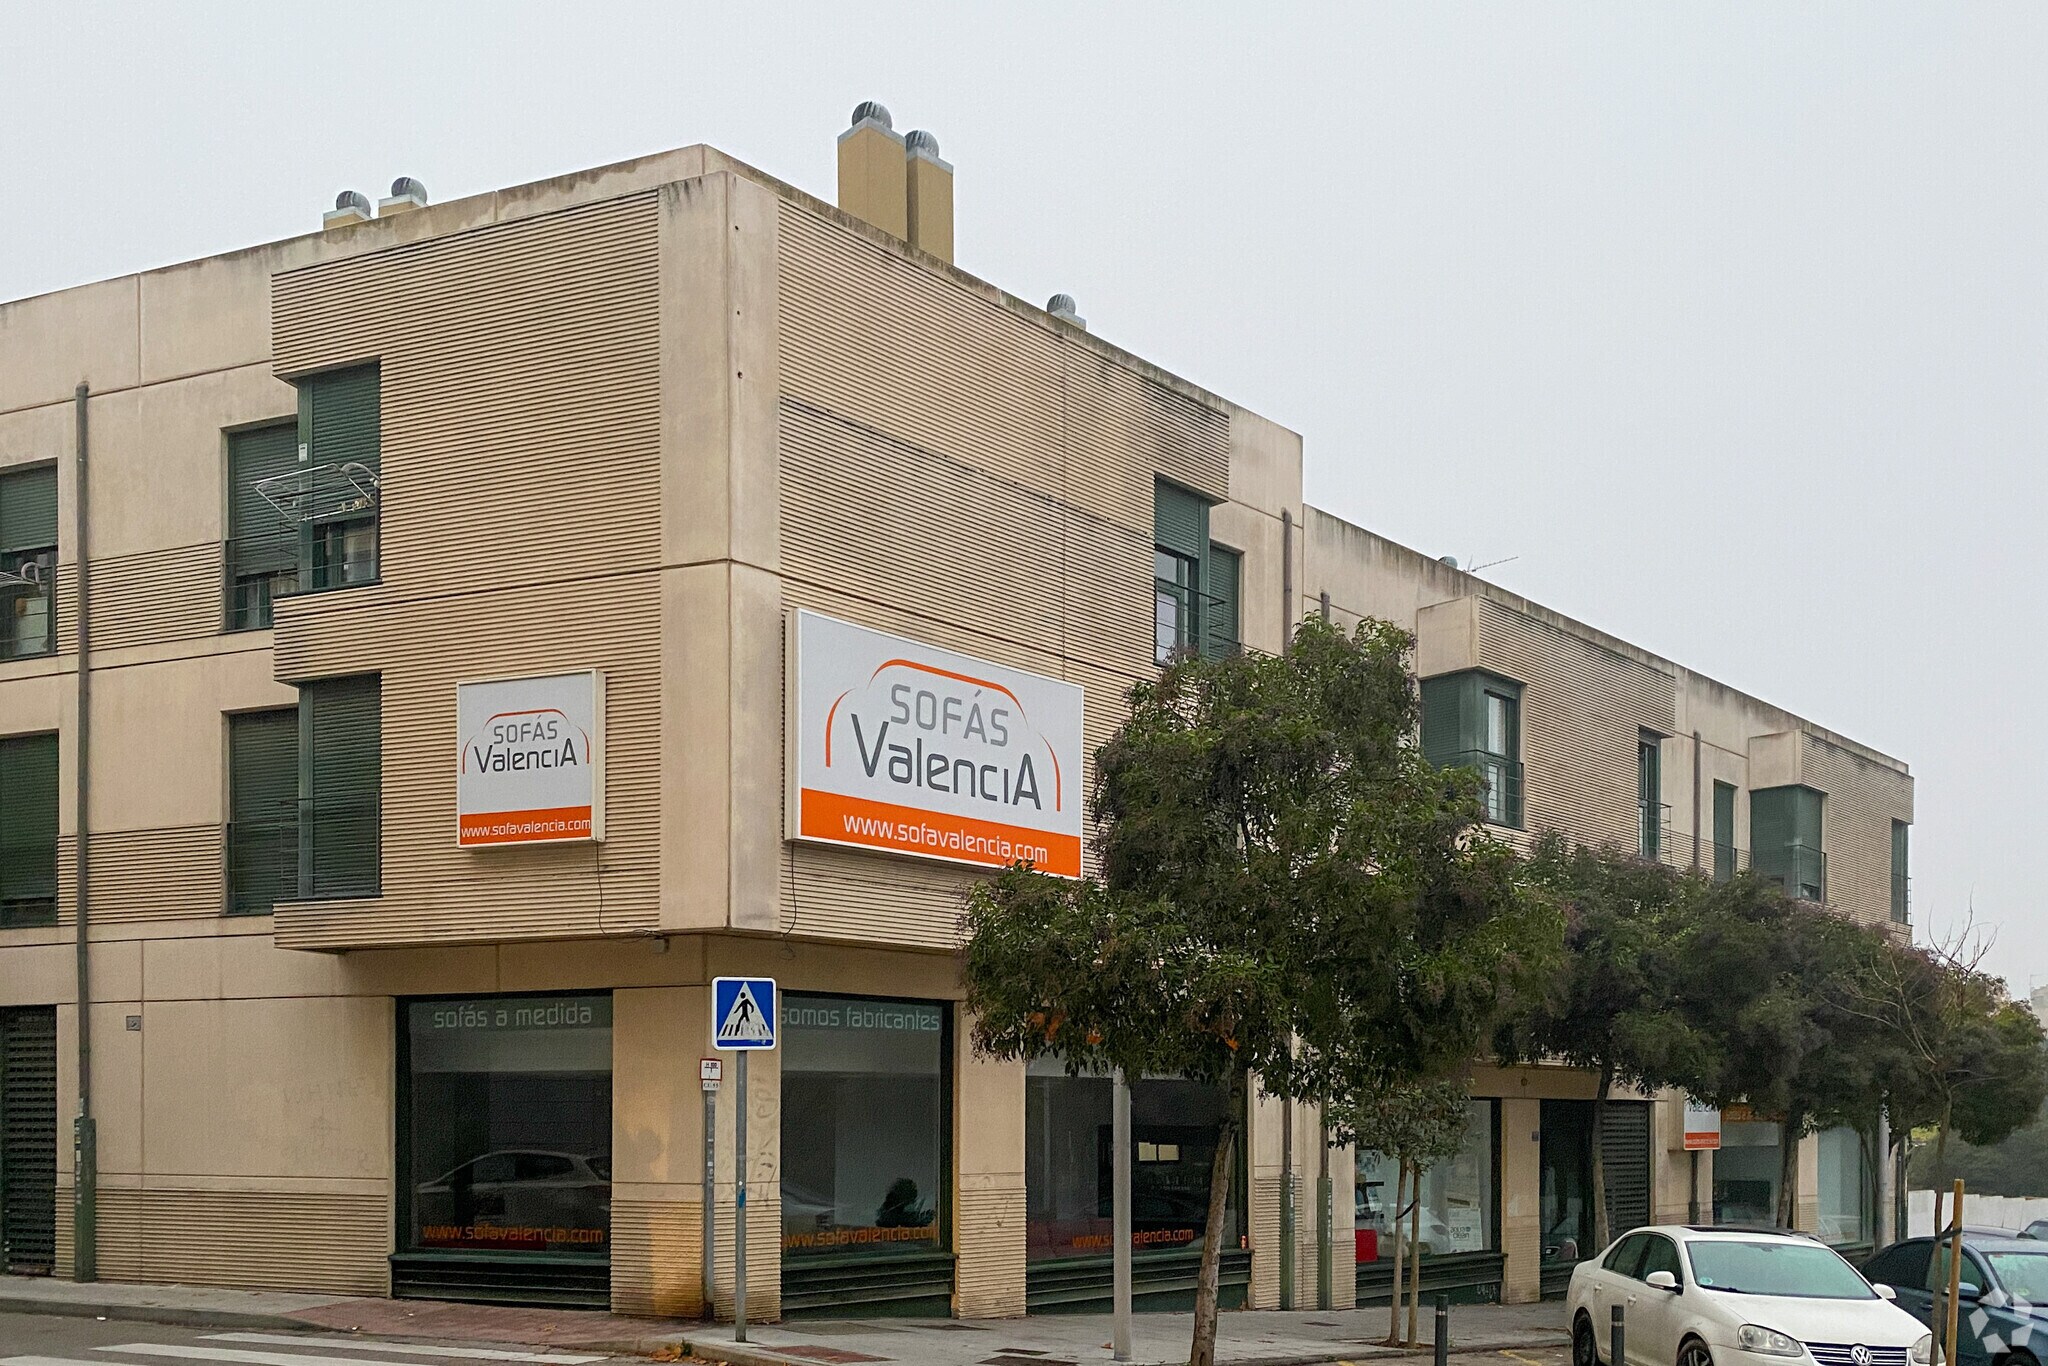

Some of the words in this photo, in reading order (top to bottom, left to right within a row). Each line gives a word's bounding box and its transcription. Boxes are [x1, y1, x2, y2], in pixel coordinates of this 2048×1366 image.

[890, 683, 1009, 747] SOFÁS
[493, 715, 558, 745] SOFÁS
[461, 818, 591, 838] www.sofavalencia.com
[843, 814, 1048, 864] www.sofavalencia.com
[434, 1004, 487, 1028] sofás
[495, 1009, 508, 1027] a
[515, 1002, 592, 1026] medida
[781, 1007, 840, 1027] somos
[846, 1006, 940, 1031] fabricantes
[422, 1223, 603, 1243] www.sofavalencia.com
